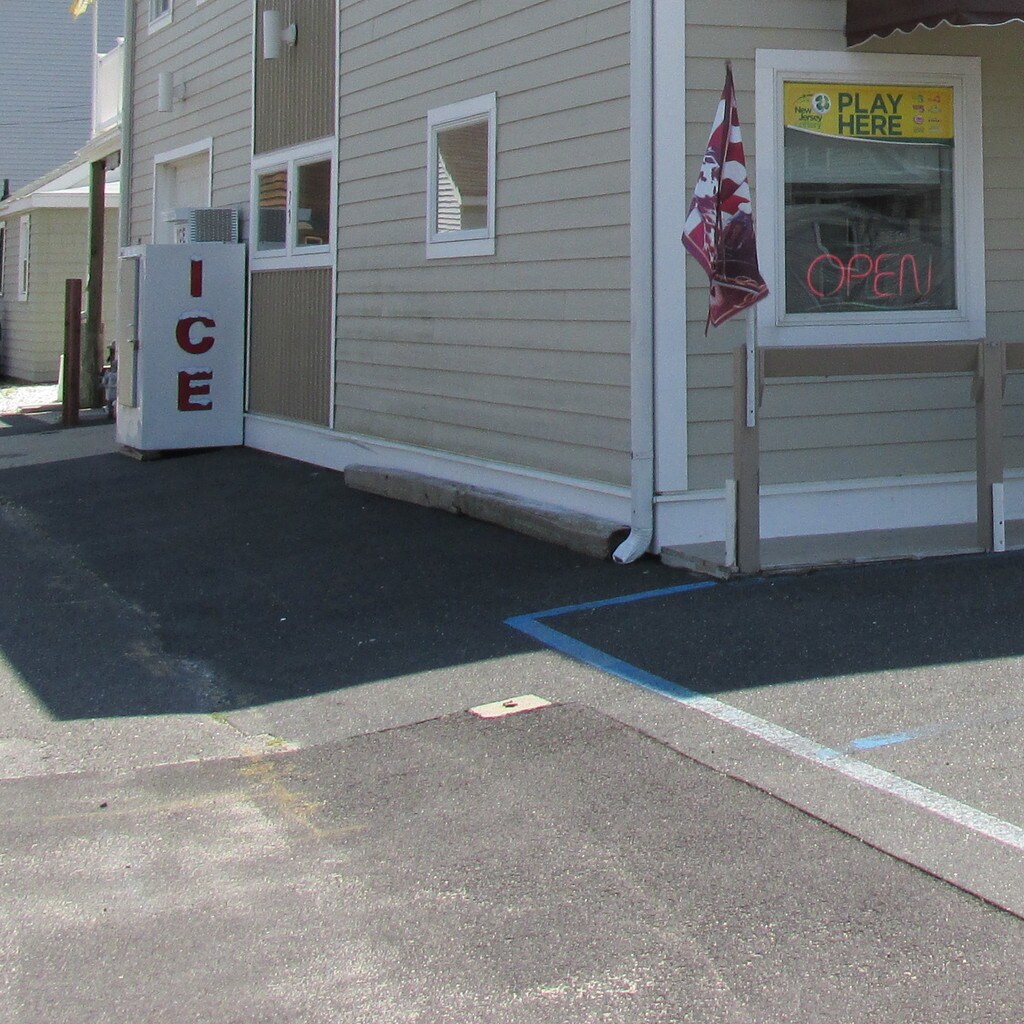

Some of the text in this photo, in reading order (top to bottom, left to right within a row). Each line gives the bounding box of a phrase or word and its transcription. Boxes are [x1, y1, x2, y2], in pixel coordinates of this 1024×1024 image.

[838, 92, 903, 114] PLAY
[838, 114, 903, 136] HERE
[807, 252, 933, 298] OPEN
[175, 255, 216, 412] ICE
